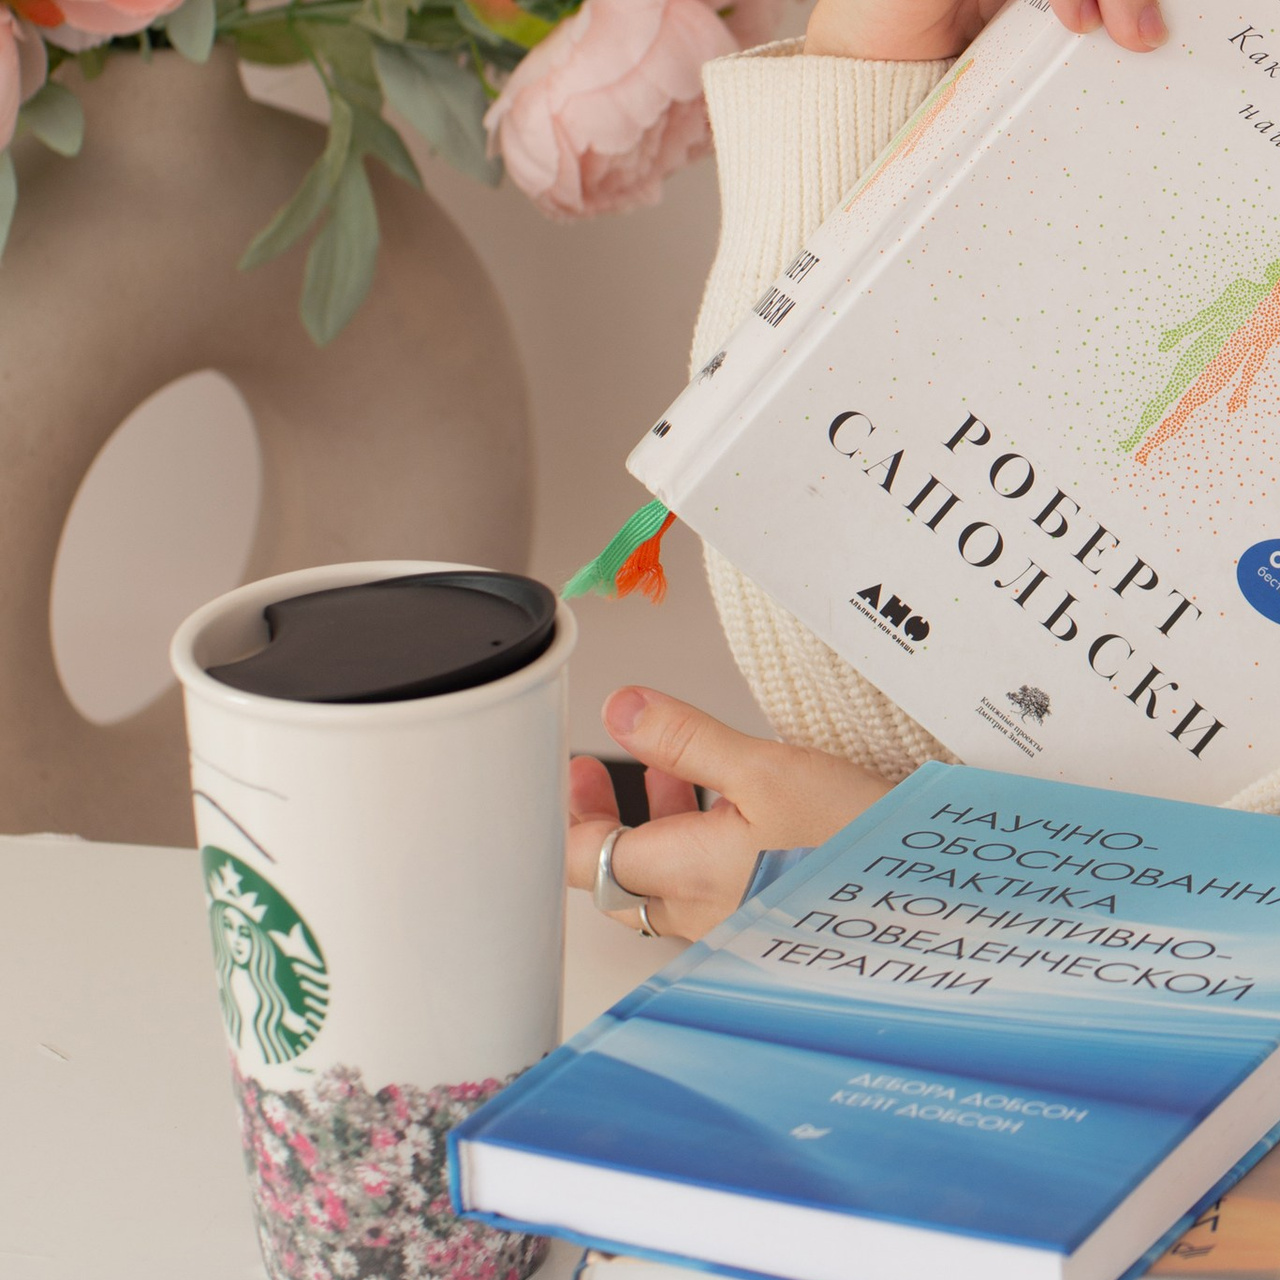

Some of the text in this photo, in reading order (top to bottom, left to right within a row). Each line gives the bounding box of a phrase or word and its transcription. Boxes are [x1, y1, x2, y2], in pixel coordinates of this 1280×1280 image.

[942, 410, 1203, 639] РОБЕРТ
[828, 410, 1229, 761] САПОЛЬСКИ
[849, 598, 915, 655] АЛЬПИНА НОН-ФИКШН
[975, 705, 1035, 758] Дмитрия Зимина
[980, 696, 1043, 753] Книжные проекты
[929, 801, 1160, 853] НАУЧНО-
[862, 855, 1118, 915] ПРАКТИКА
[828, 882, 1233, 962] В КОГНИТИВНО-
[760, 937, 993, 996] ТЕРАПИИ
[792, 910, 1256, 1003] ПОВЕДЕНЧЕСКОЙ
[829, 1088, 1025, 1135] КЕЙТ ДОБСОН
[847, 1071, 1090, 1124] ДЕБОРА ДОБСОН
